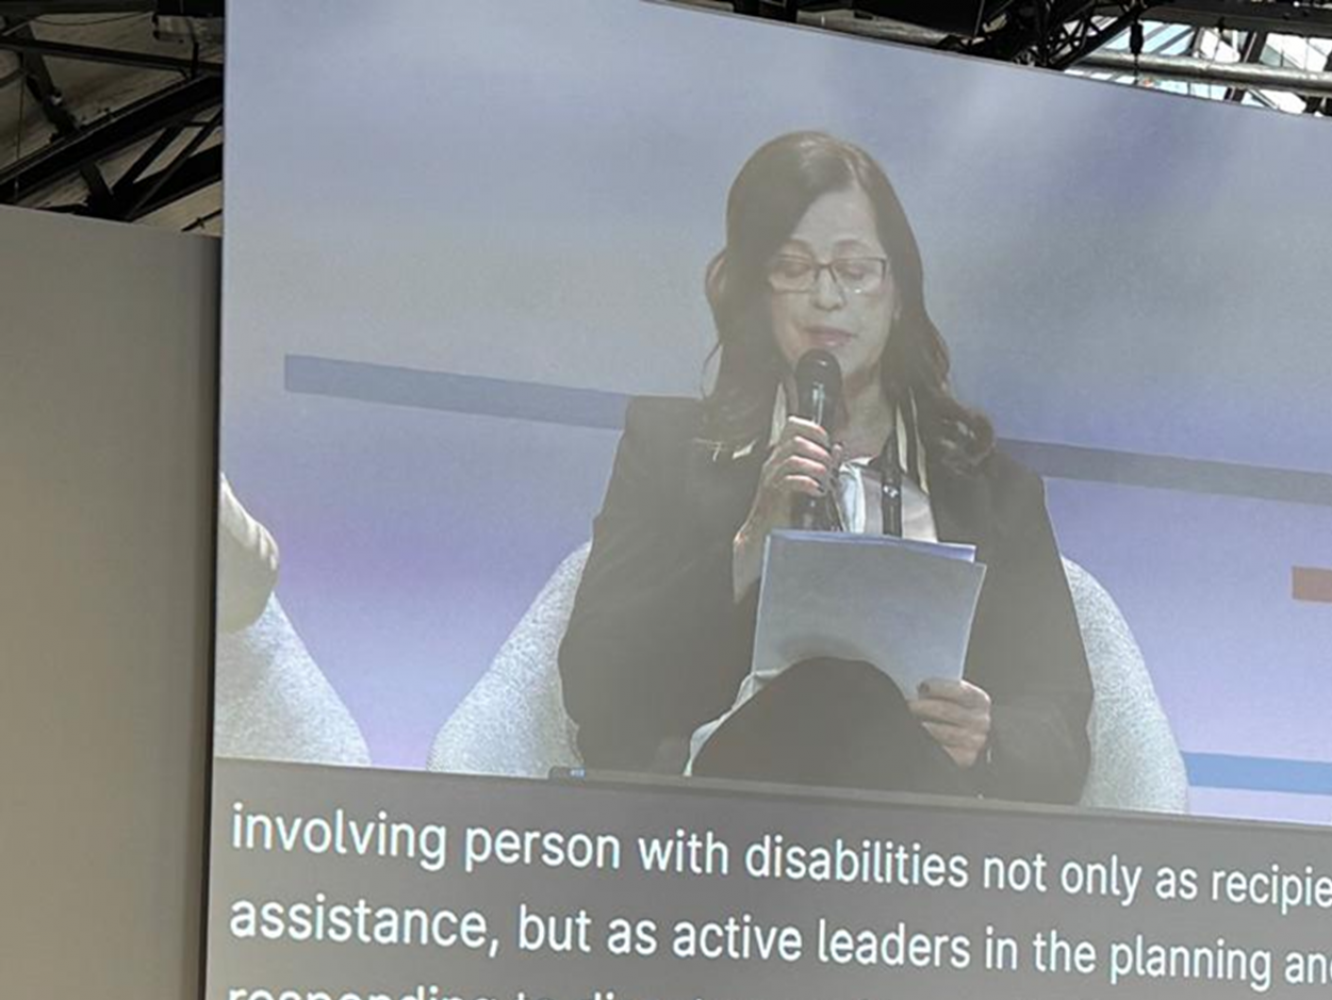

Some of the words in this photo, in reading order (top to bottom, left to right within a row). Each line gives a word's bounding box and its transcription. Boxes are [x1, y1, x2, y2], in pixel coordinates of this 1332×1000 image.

[232, 801, 447, 872] involving
[465, 825, 621, 873] person
[638, 829, 730, 877] with
[745, 834, 968, 889] disabilities
[983, 852, 1047, 894] not
[1060, 854, 1142, 906] only
[1155, 865, 1198, 900] as
[229, 893, 500, 958] assistance,
[518, 903, 592, 954] but
[606, 917, 659, 957] as
[672, 914, 803, 964] active
[817, 918, 970, 969] leaders
[985, 926, 1018, 971] in
[1033, 929, 1097, 976] the
[1110, 933, 1272, 993] planning
